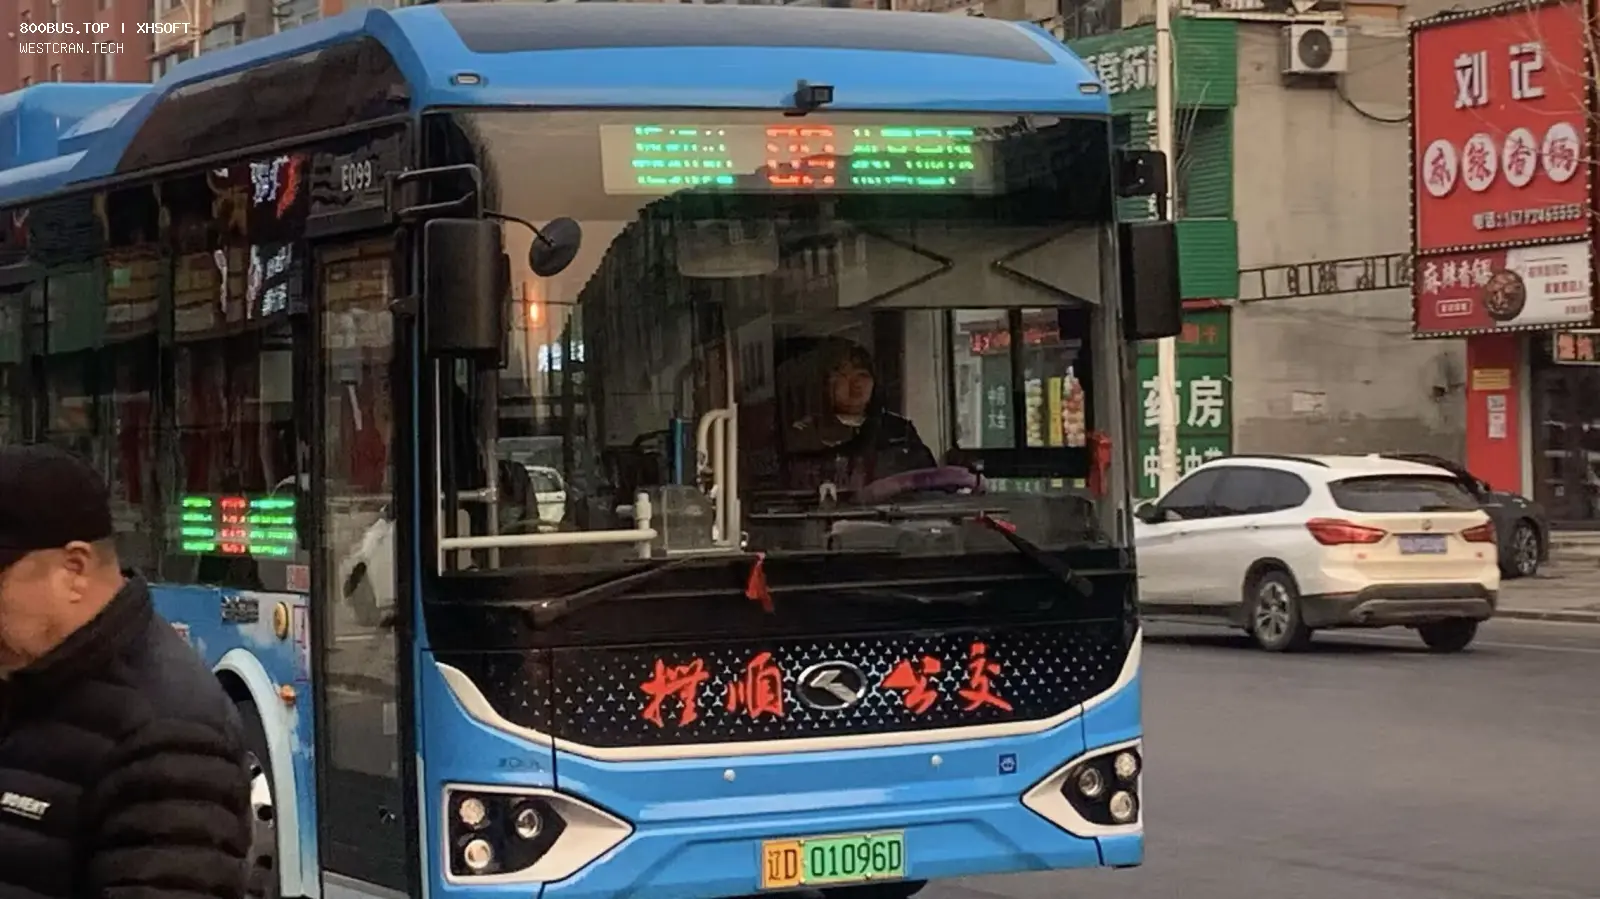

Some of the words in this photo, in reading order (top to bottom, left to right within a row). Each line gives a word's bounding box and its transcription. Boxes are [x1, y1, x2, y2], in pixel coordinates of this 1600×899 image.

[1454, 42, 1547, 109] 刘记
[341, 160, 373, 192] E099
[768, 848, 798, 881] 辽D
[811, 840, 902, 877] 01096D
